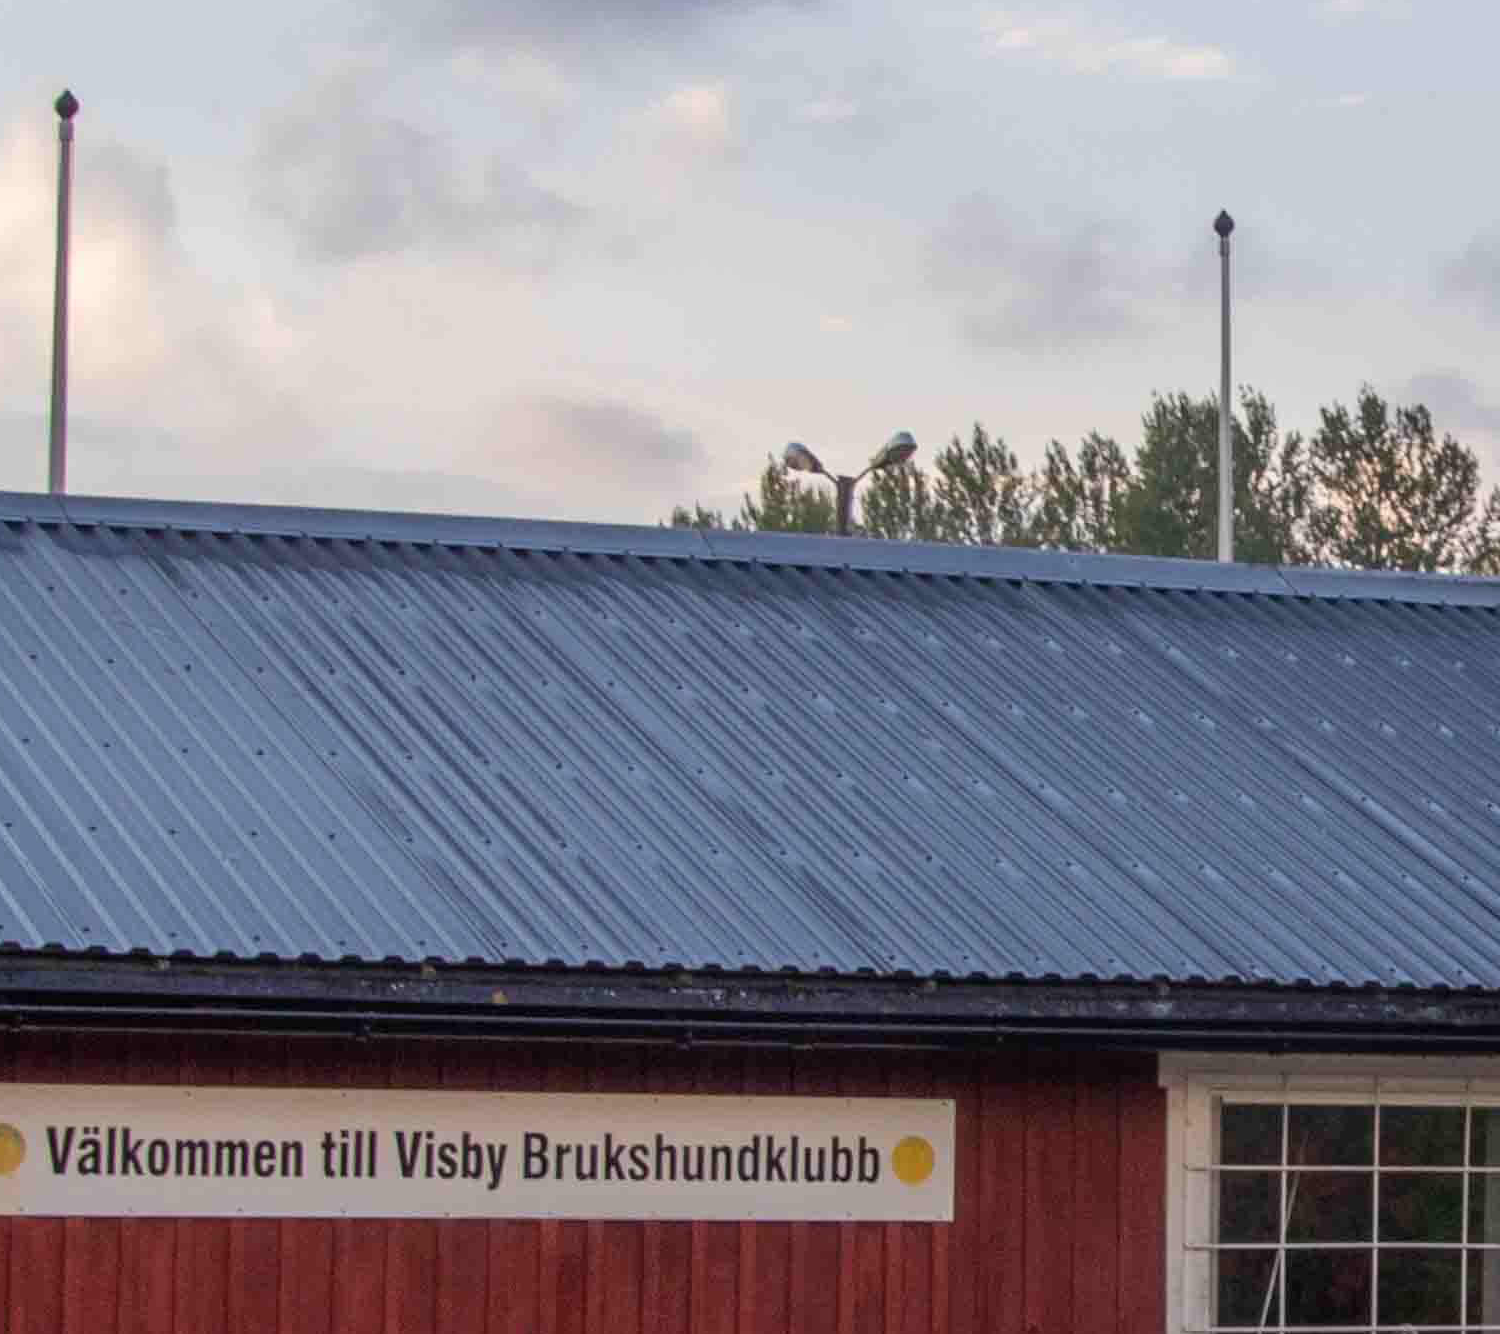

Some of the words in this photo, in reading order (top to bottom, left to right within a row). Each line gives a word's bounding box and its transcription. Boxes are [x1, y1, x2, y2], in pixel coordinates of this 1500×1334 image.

[45, 1126, 303, 1178] Välkommen
[321, 1130, 377, 1179] till
[394, 1131, 508, 1191] Visby
[522, 1132, 881, 1183] Brukshundklubb
